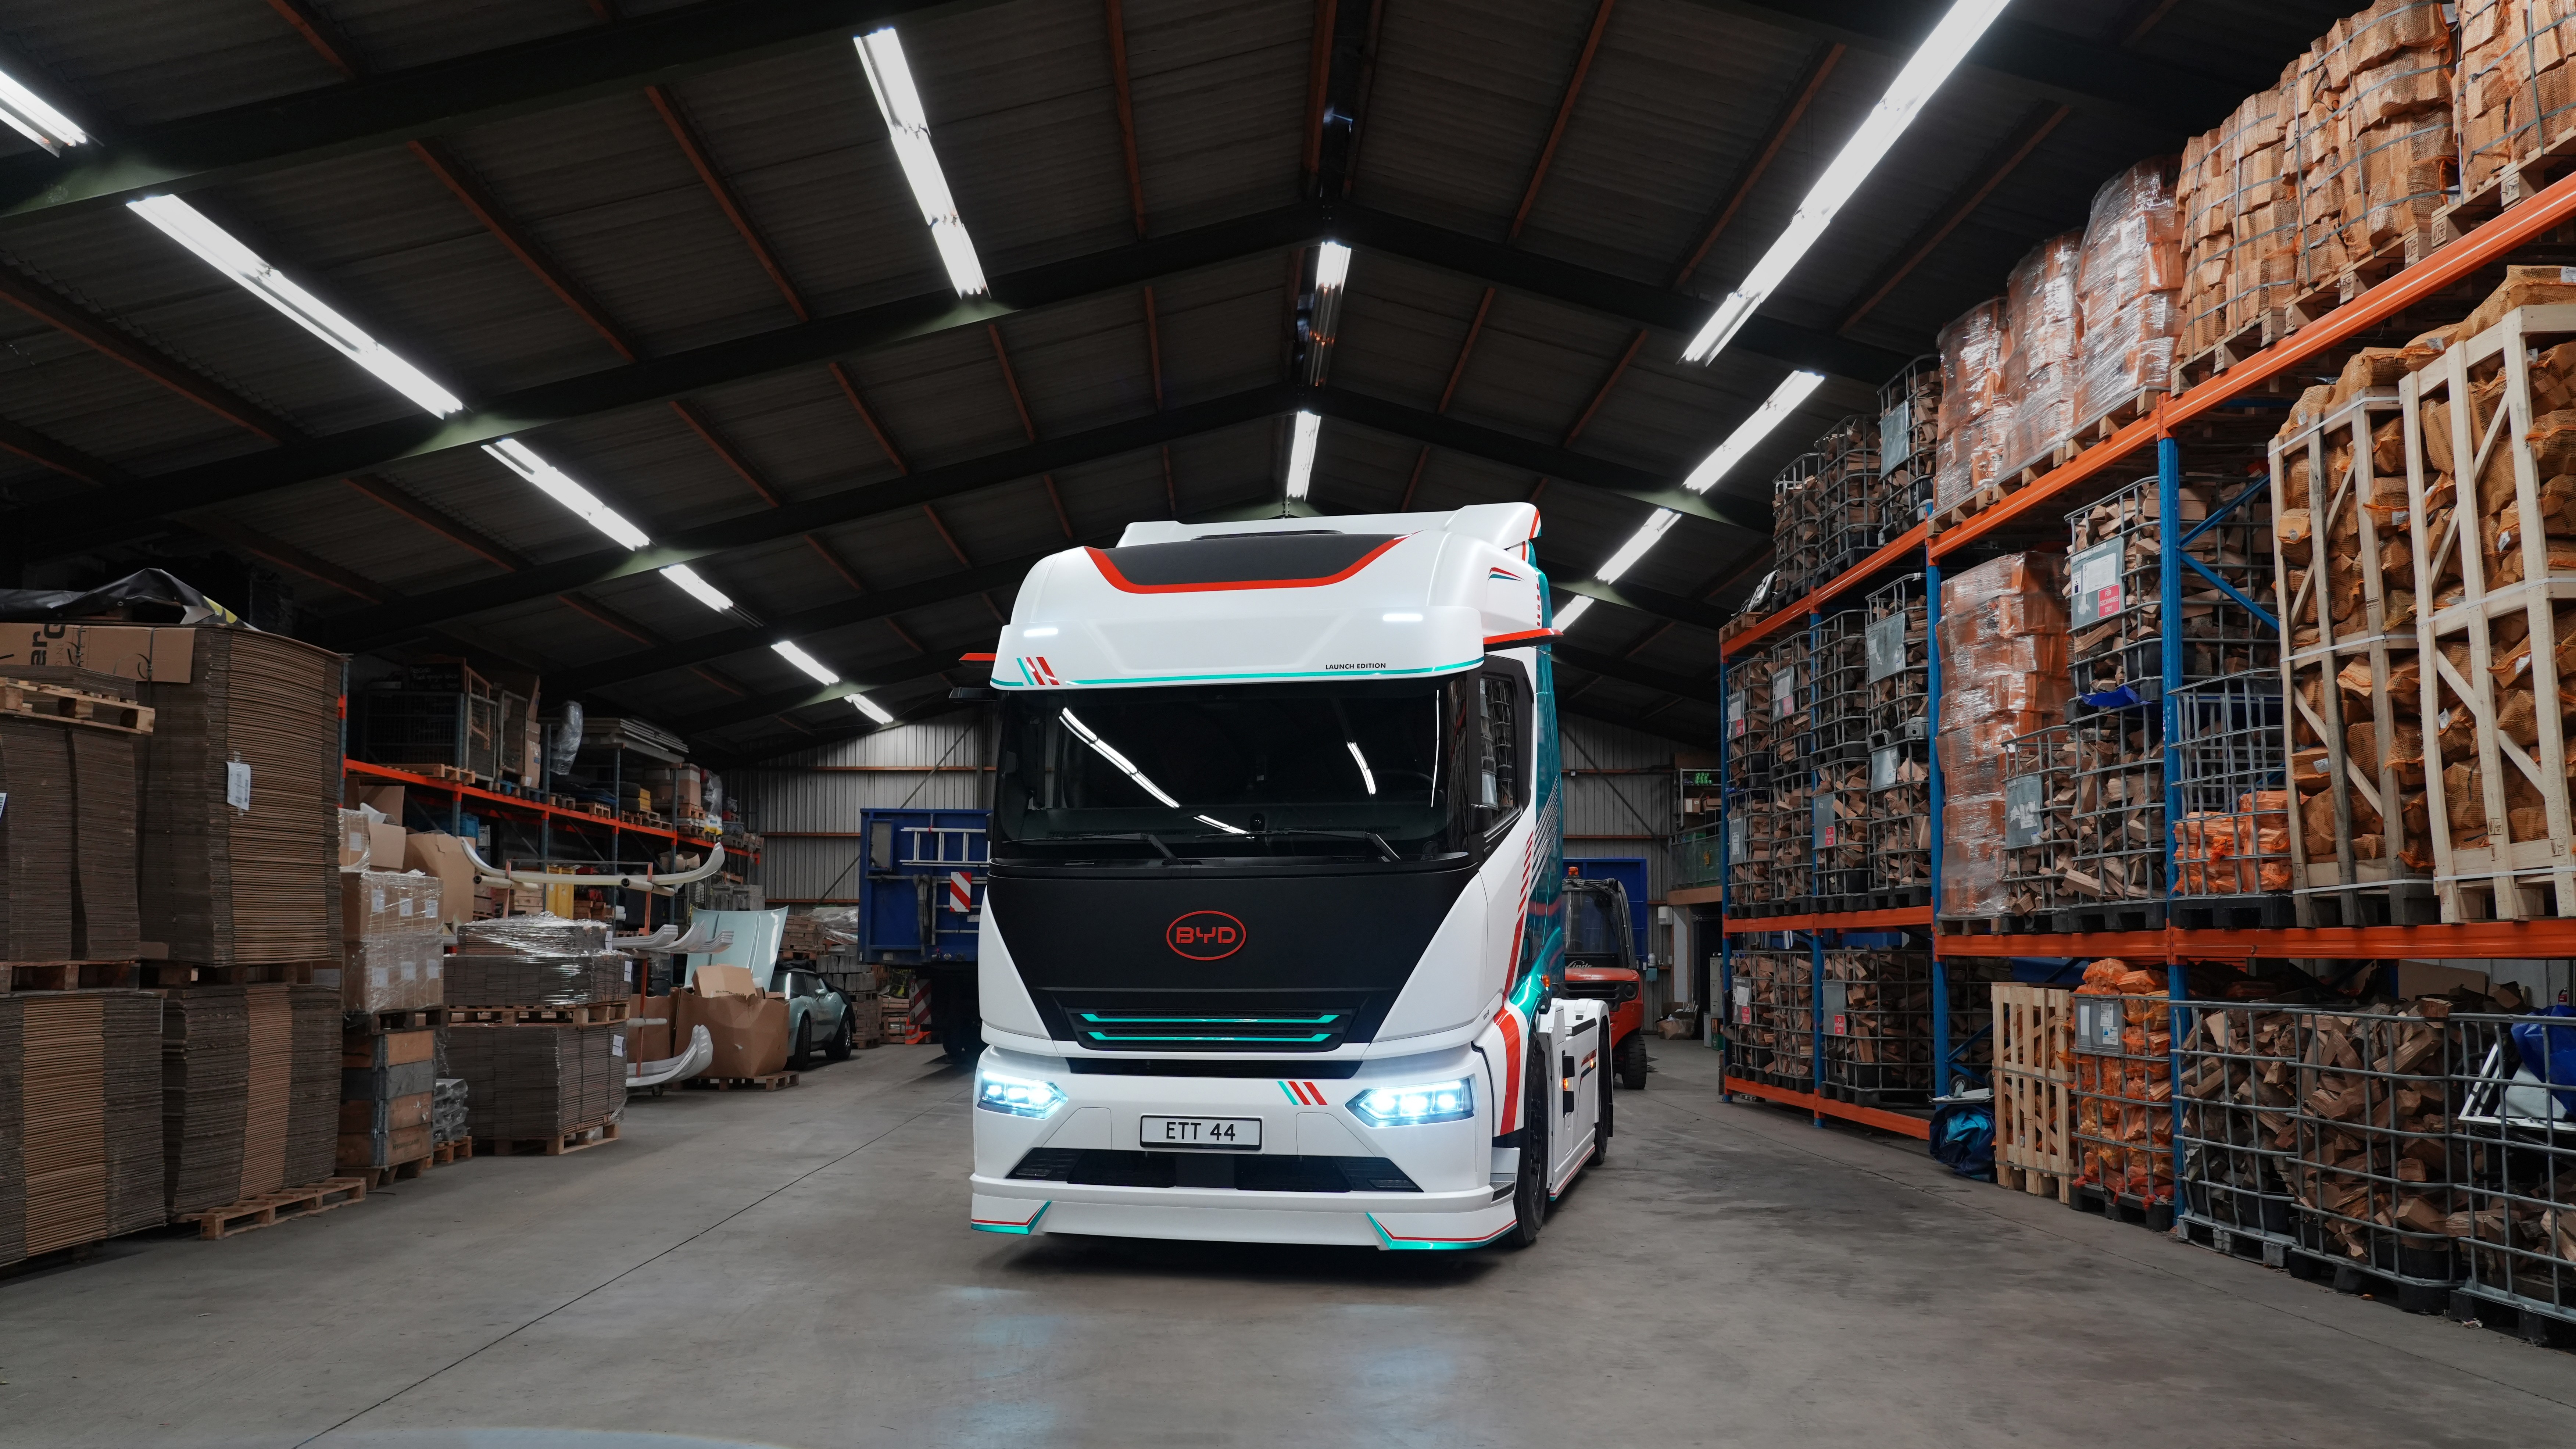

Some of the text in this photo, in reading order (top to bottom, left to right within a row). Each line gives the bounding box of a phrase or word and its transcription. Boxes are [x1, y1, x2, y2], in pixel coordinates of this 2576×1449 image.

[2100, 596, 2119, 607] ISOCYANATES
[1176, 927, 1236, 944] BYD
[1166, 1121, 1236, 1141] ETT 44
